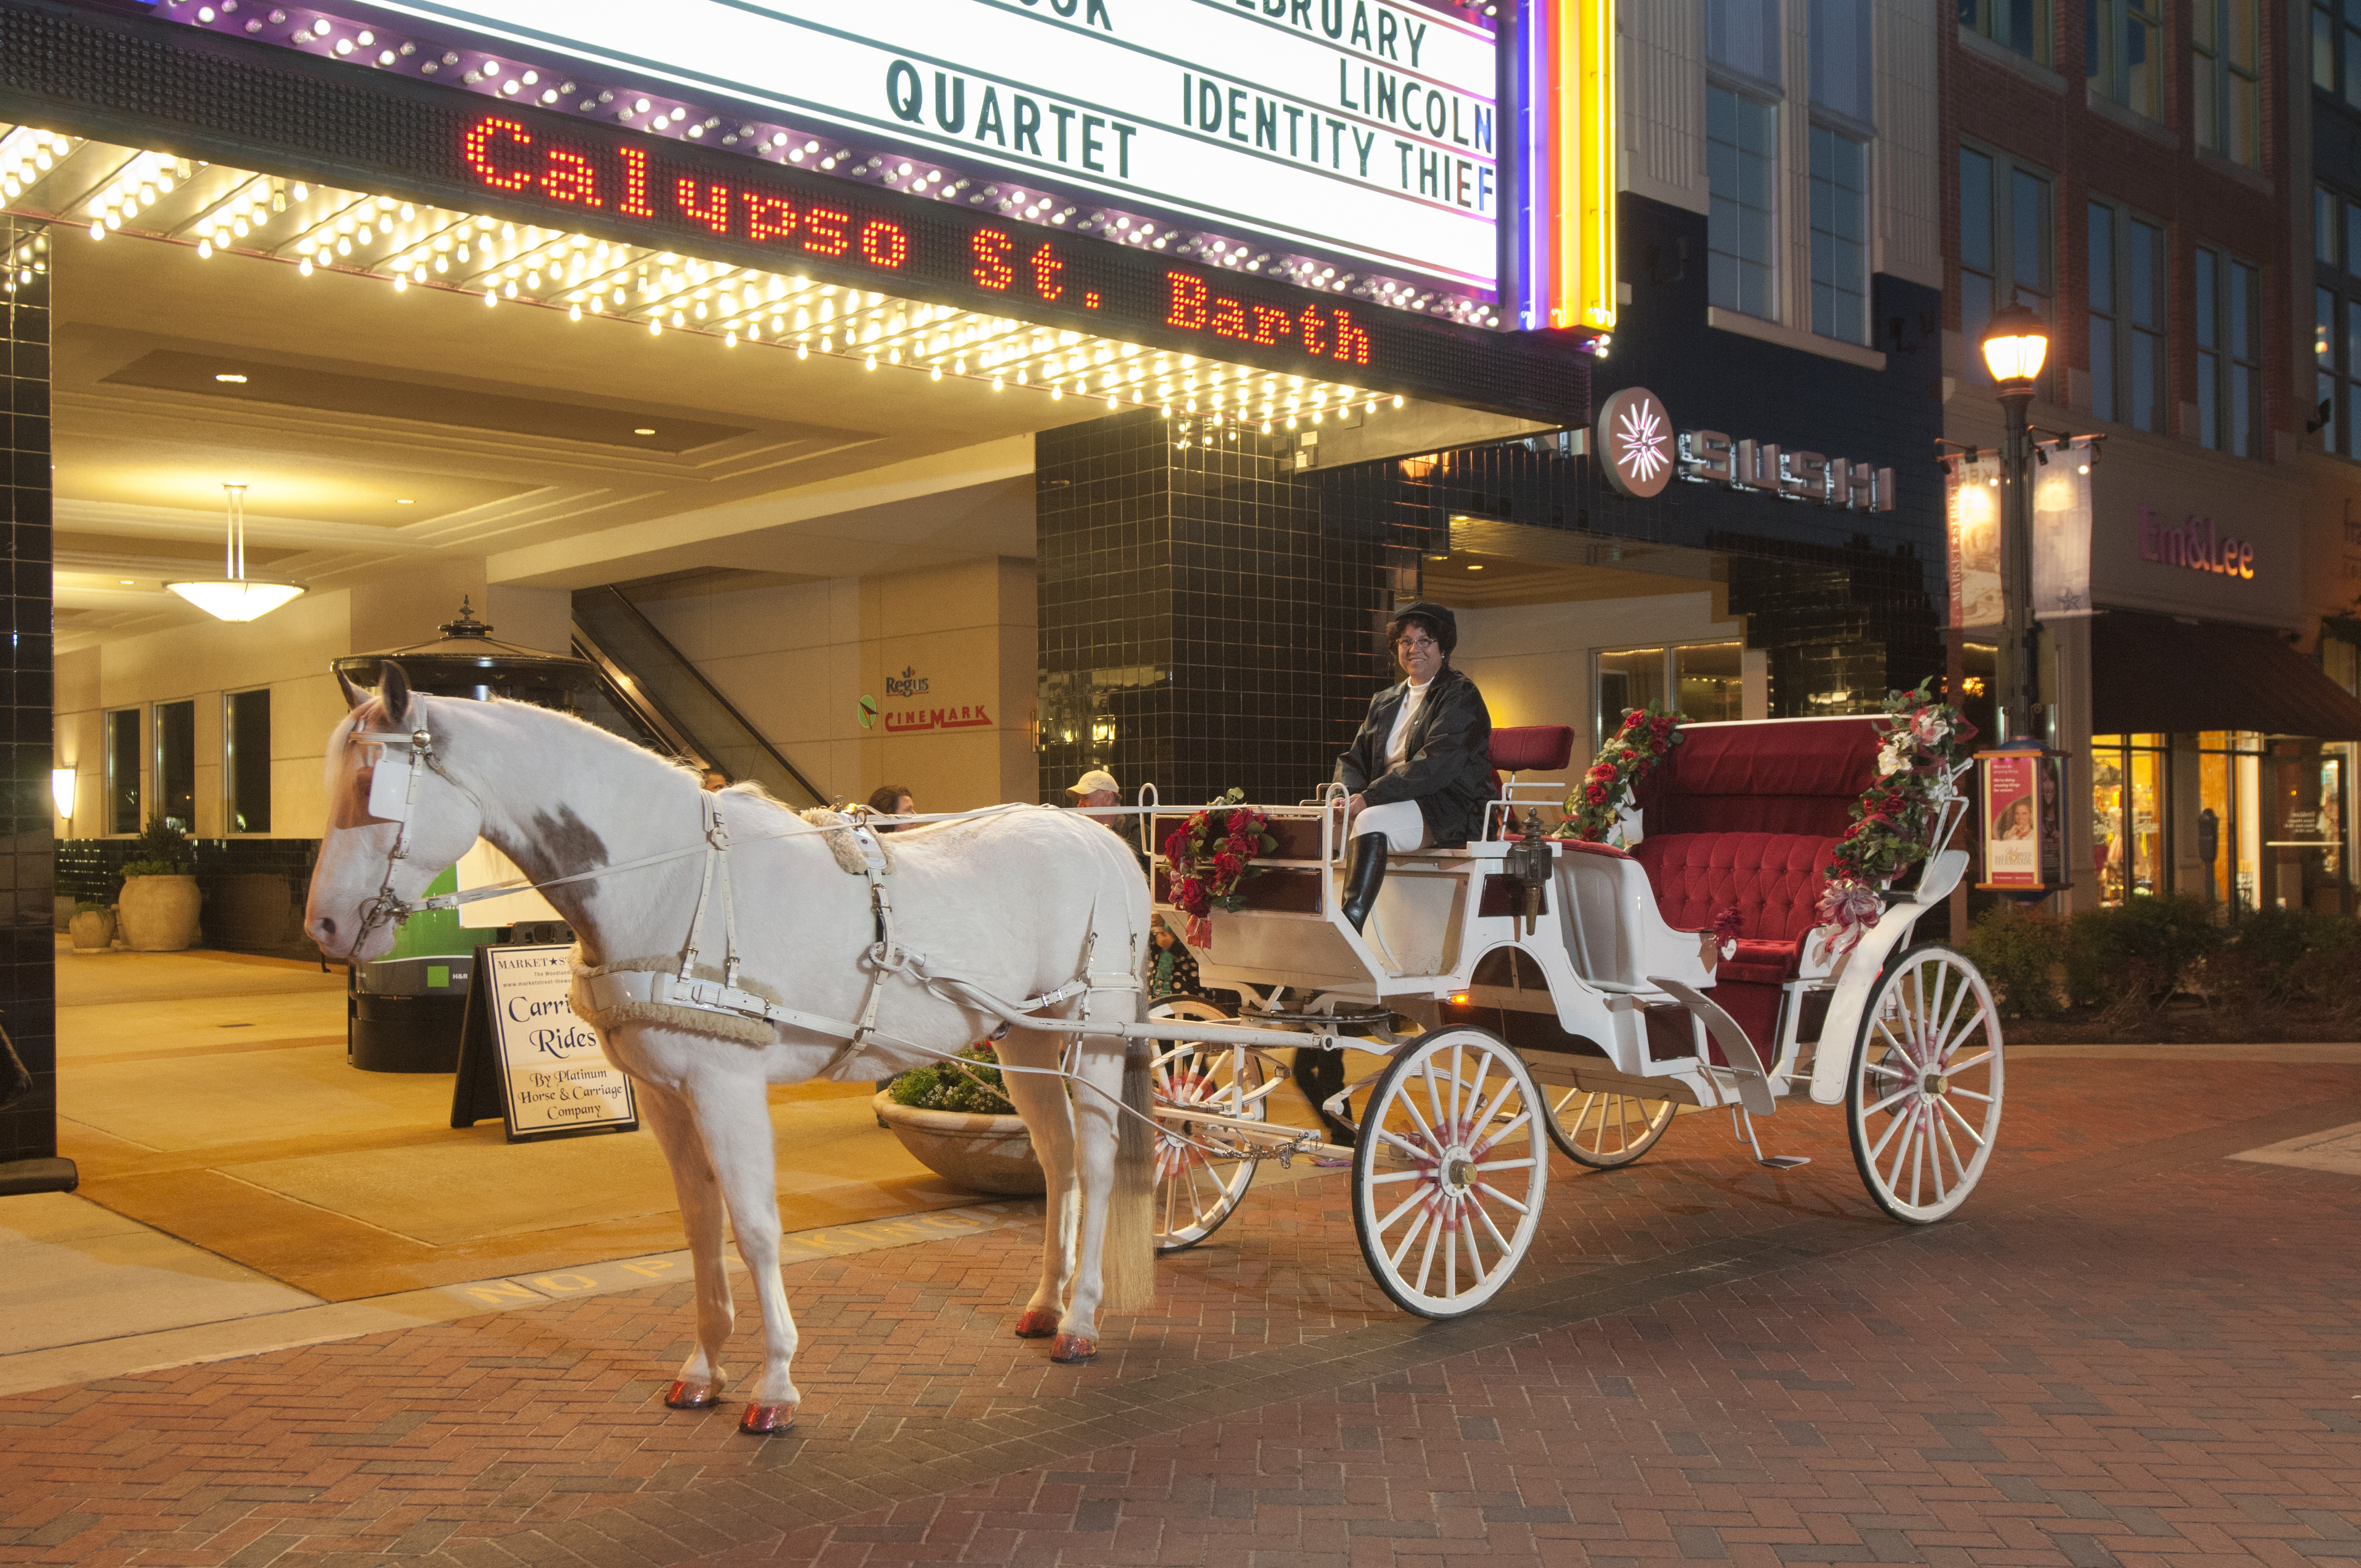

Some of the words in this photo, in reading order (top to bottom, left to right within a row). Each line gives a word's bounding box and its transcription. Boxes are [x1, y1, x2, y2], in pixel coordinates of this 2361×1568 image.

[1236, 0, 1427, 69] RUARY
[886, 59, 1137, 179] QUARTET
[1340, 57, 1492, 154] LINCOLN
[1183, 72, 1375, 178] IDENTITY
[1394, 140, 1493, 212] THIEF
[466, 116, 907, 269] Calypso
[972, 229, 1100, 310] St.
[1166, 271, 1369, 365] Barth
[1689, 429, 1896, 512] SUSHI
[1948, 485, 1959, 535] STREET
[1951, 547, 1962, 602] MARKET
[886, 677, 929, 698] Regus
[885, 705, 993, 733] CINEMARK
[498, 958, 548, 969] MARKET
[503, 979, 571, 987] www.marketstreet-thewo
[509, 993, 573, 1023] Carri
[529, 1027, 596, 1059] Rides
[518, 1091, 556, 1103] Horse
[560, 1088, 571, 1101] &
[573, 1084, 623, 1099] Carriage
[529, 1072, 551, 1087] By
[554, 1069, 607, 1087] Platinum
[547, 1103, 601, 1120] Company
[465, 1273, 598, 1304] NO
[620, 1215, 982, 1279] PKING
